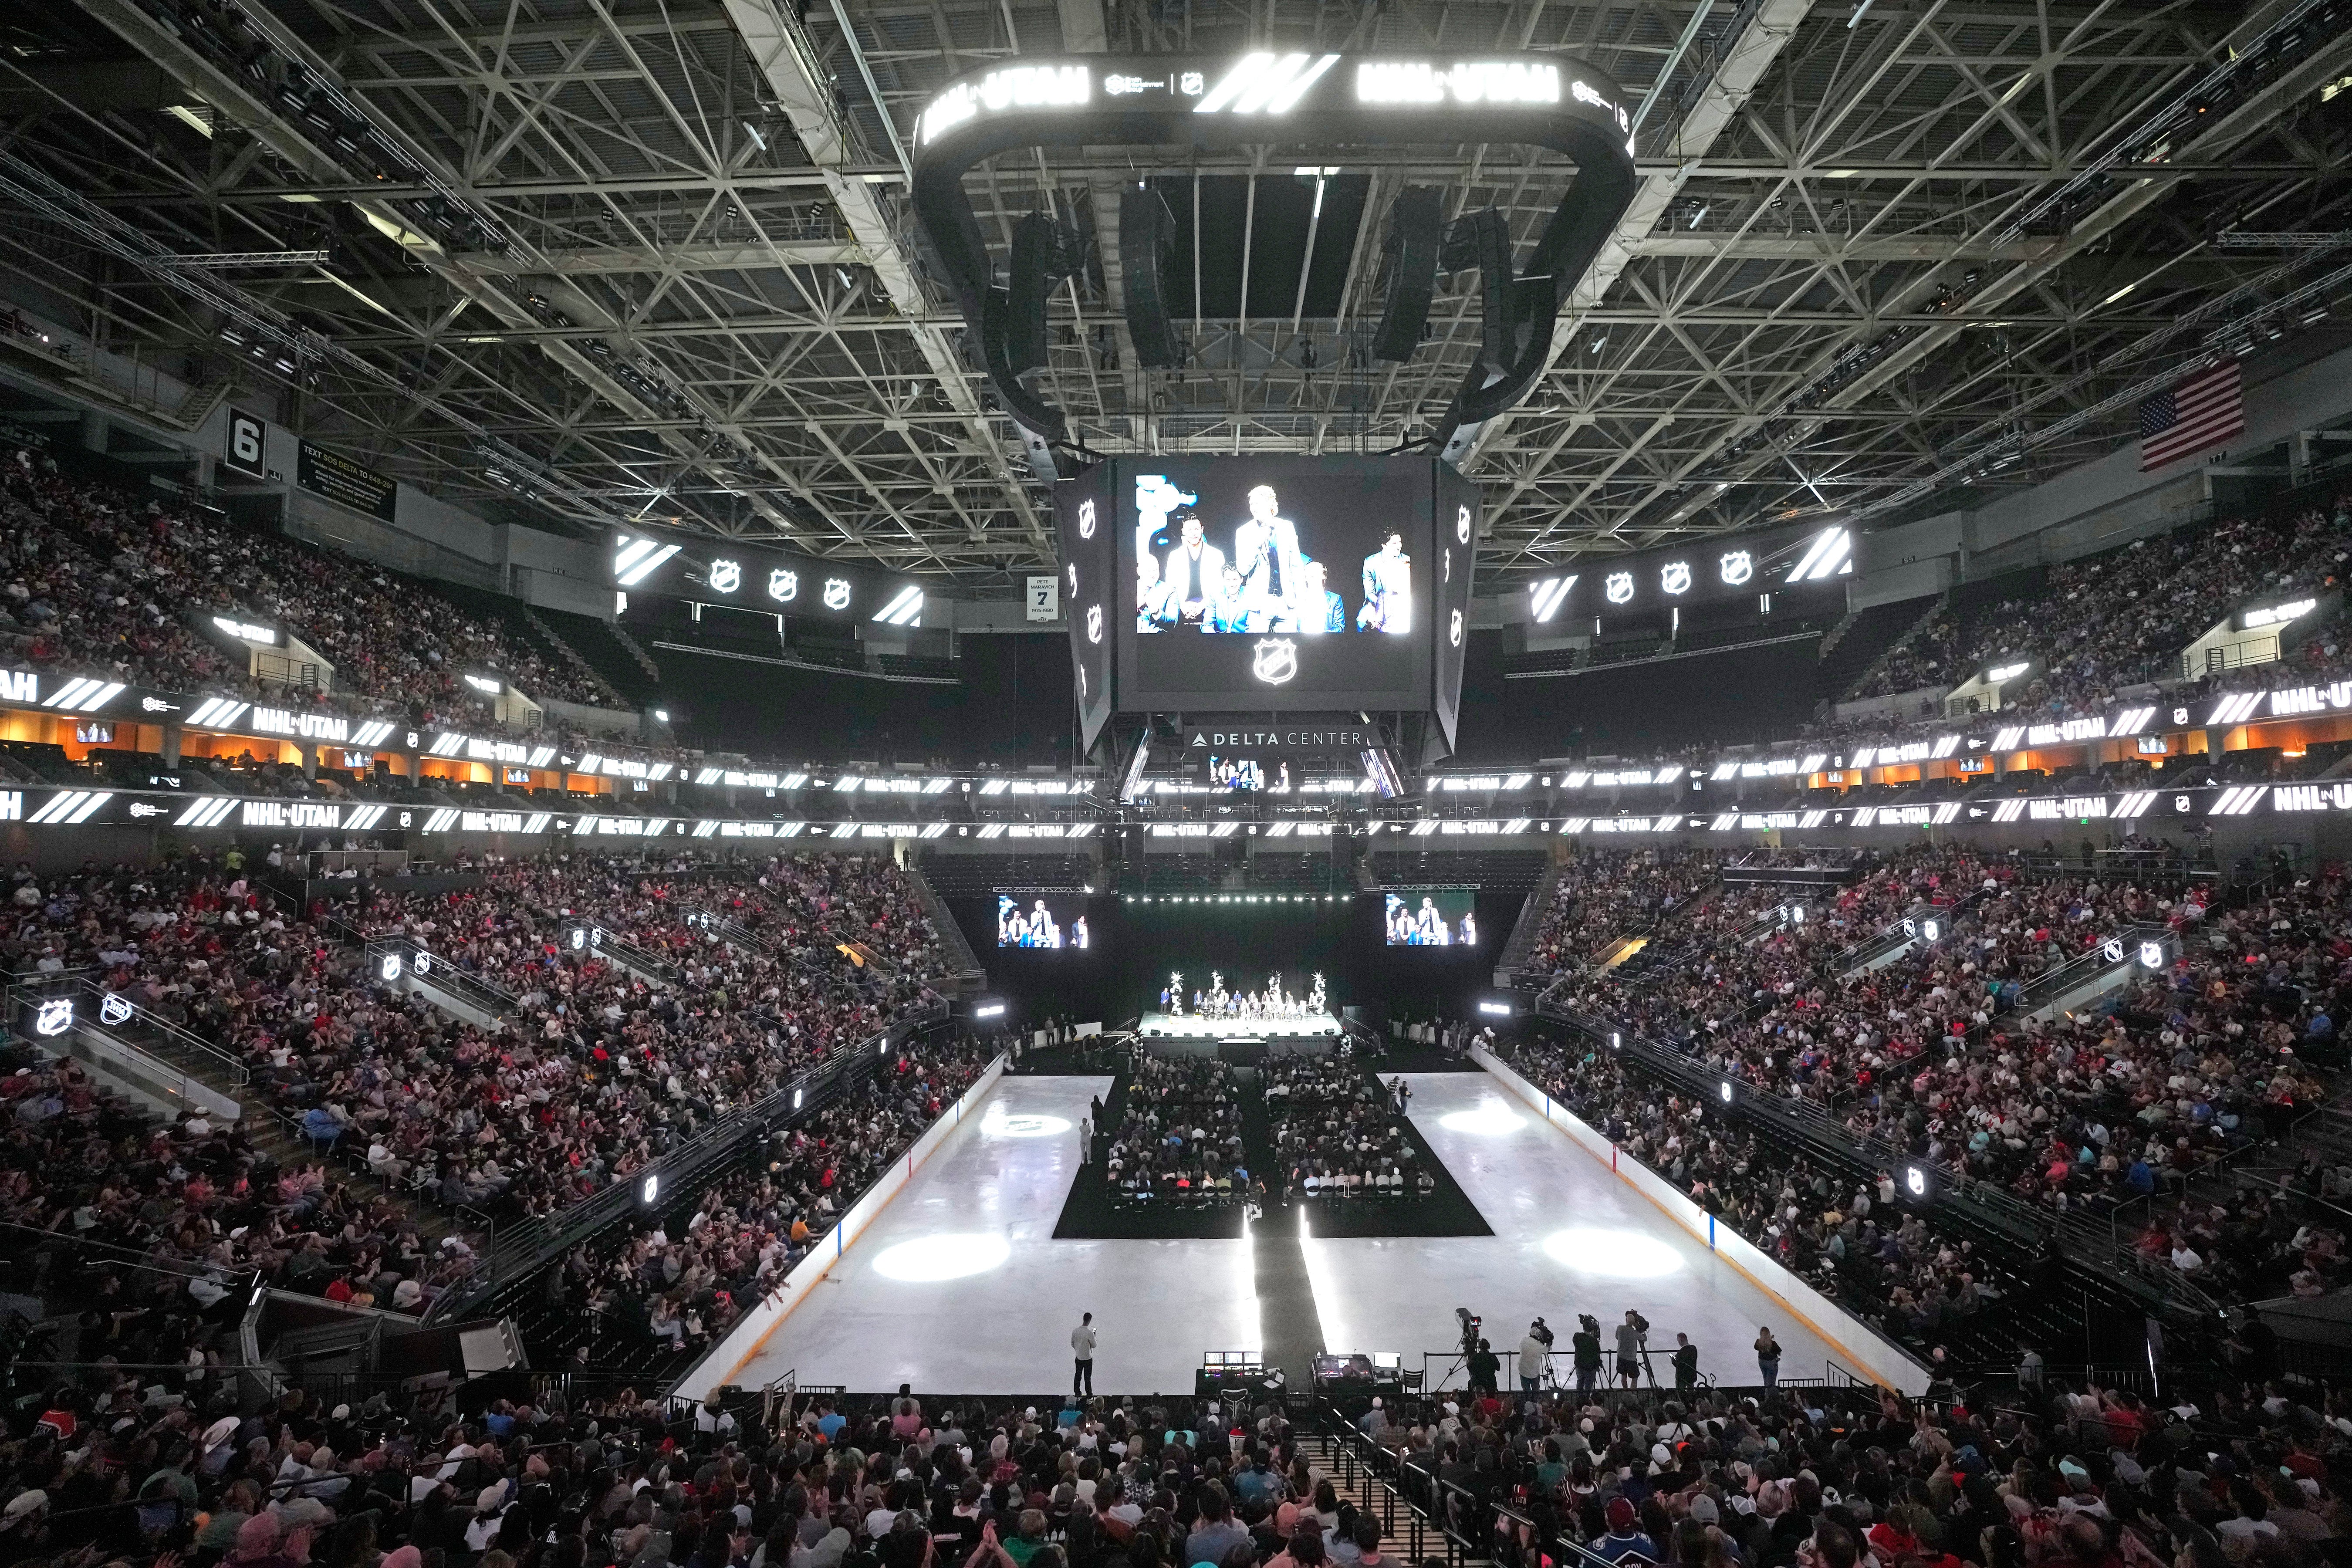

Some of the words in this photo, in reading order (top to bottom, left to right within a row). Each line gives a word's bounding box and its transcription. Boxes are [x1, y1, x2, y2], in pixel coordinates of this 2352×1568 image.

[970, 85, 987, 100] IN
[987, 67, 1088, 108] UTAH
[1435, 71, 1454, 88] IN
[1454, 64, 1558, 101] UTAH
[234, 418, 259, 462] 6
[304, 445, 322, 459] TEXT
[323, 454, 337, 466] SOS
[339, 461, 358, 474] DELTA
[359, 470, 368, 479] TO
[1037, 592, 1048, 605] 7
[2271, 687, 2325, 715] NHL
[2318, 690, 2331, 700] IN
[253, 707, 294, 734] NHL
[301, 714, 347, 740] UTAH
[2029, 724, 2060, 745] NHL
[2062, 717, 2105, 740] UTAH
[1214, 733, 1279, 745] DELTA
[1288, 733, 1361, 745] CENTER
[497, 743, 526, 763] UTAH
[1901, 742, 1929, 761] UTAH
[1769, 760, 1796, 775] UTAH
[1470, 777, 1500, 790] UTAH
[1620, 771, 1651, 784] UTAH
[891, 780, 920, 792] UTAH
[1037, 782, 1066, 794] UTAH
[2274, 786, 2327, 811] NHL
[2321, 790, 2333, 800] IN
[243, 802, 285, 825] NHL
[291, 804, 339, 827] UTAH
[1902, 807, 1930, 823] UTAH
[2030, 800, 2061, 818] NHL
[2064, 798, 2106, 818] UTAH
[491, 814, 521, 831] UTAH
[1468, 821, 1498, 833] UTAH
[1619, 818, 1650, 831] UTAH
[1768, 814, 1796, 828] UTAH
[888, 825, 917, 837] UTAH
[1035, 826, 1063, 837] UTAH
[1178, 825, 1207, 836] UTAH
